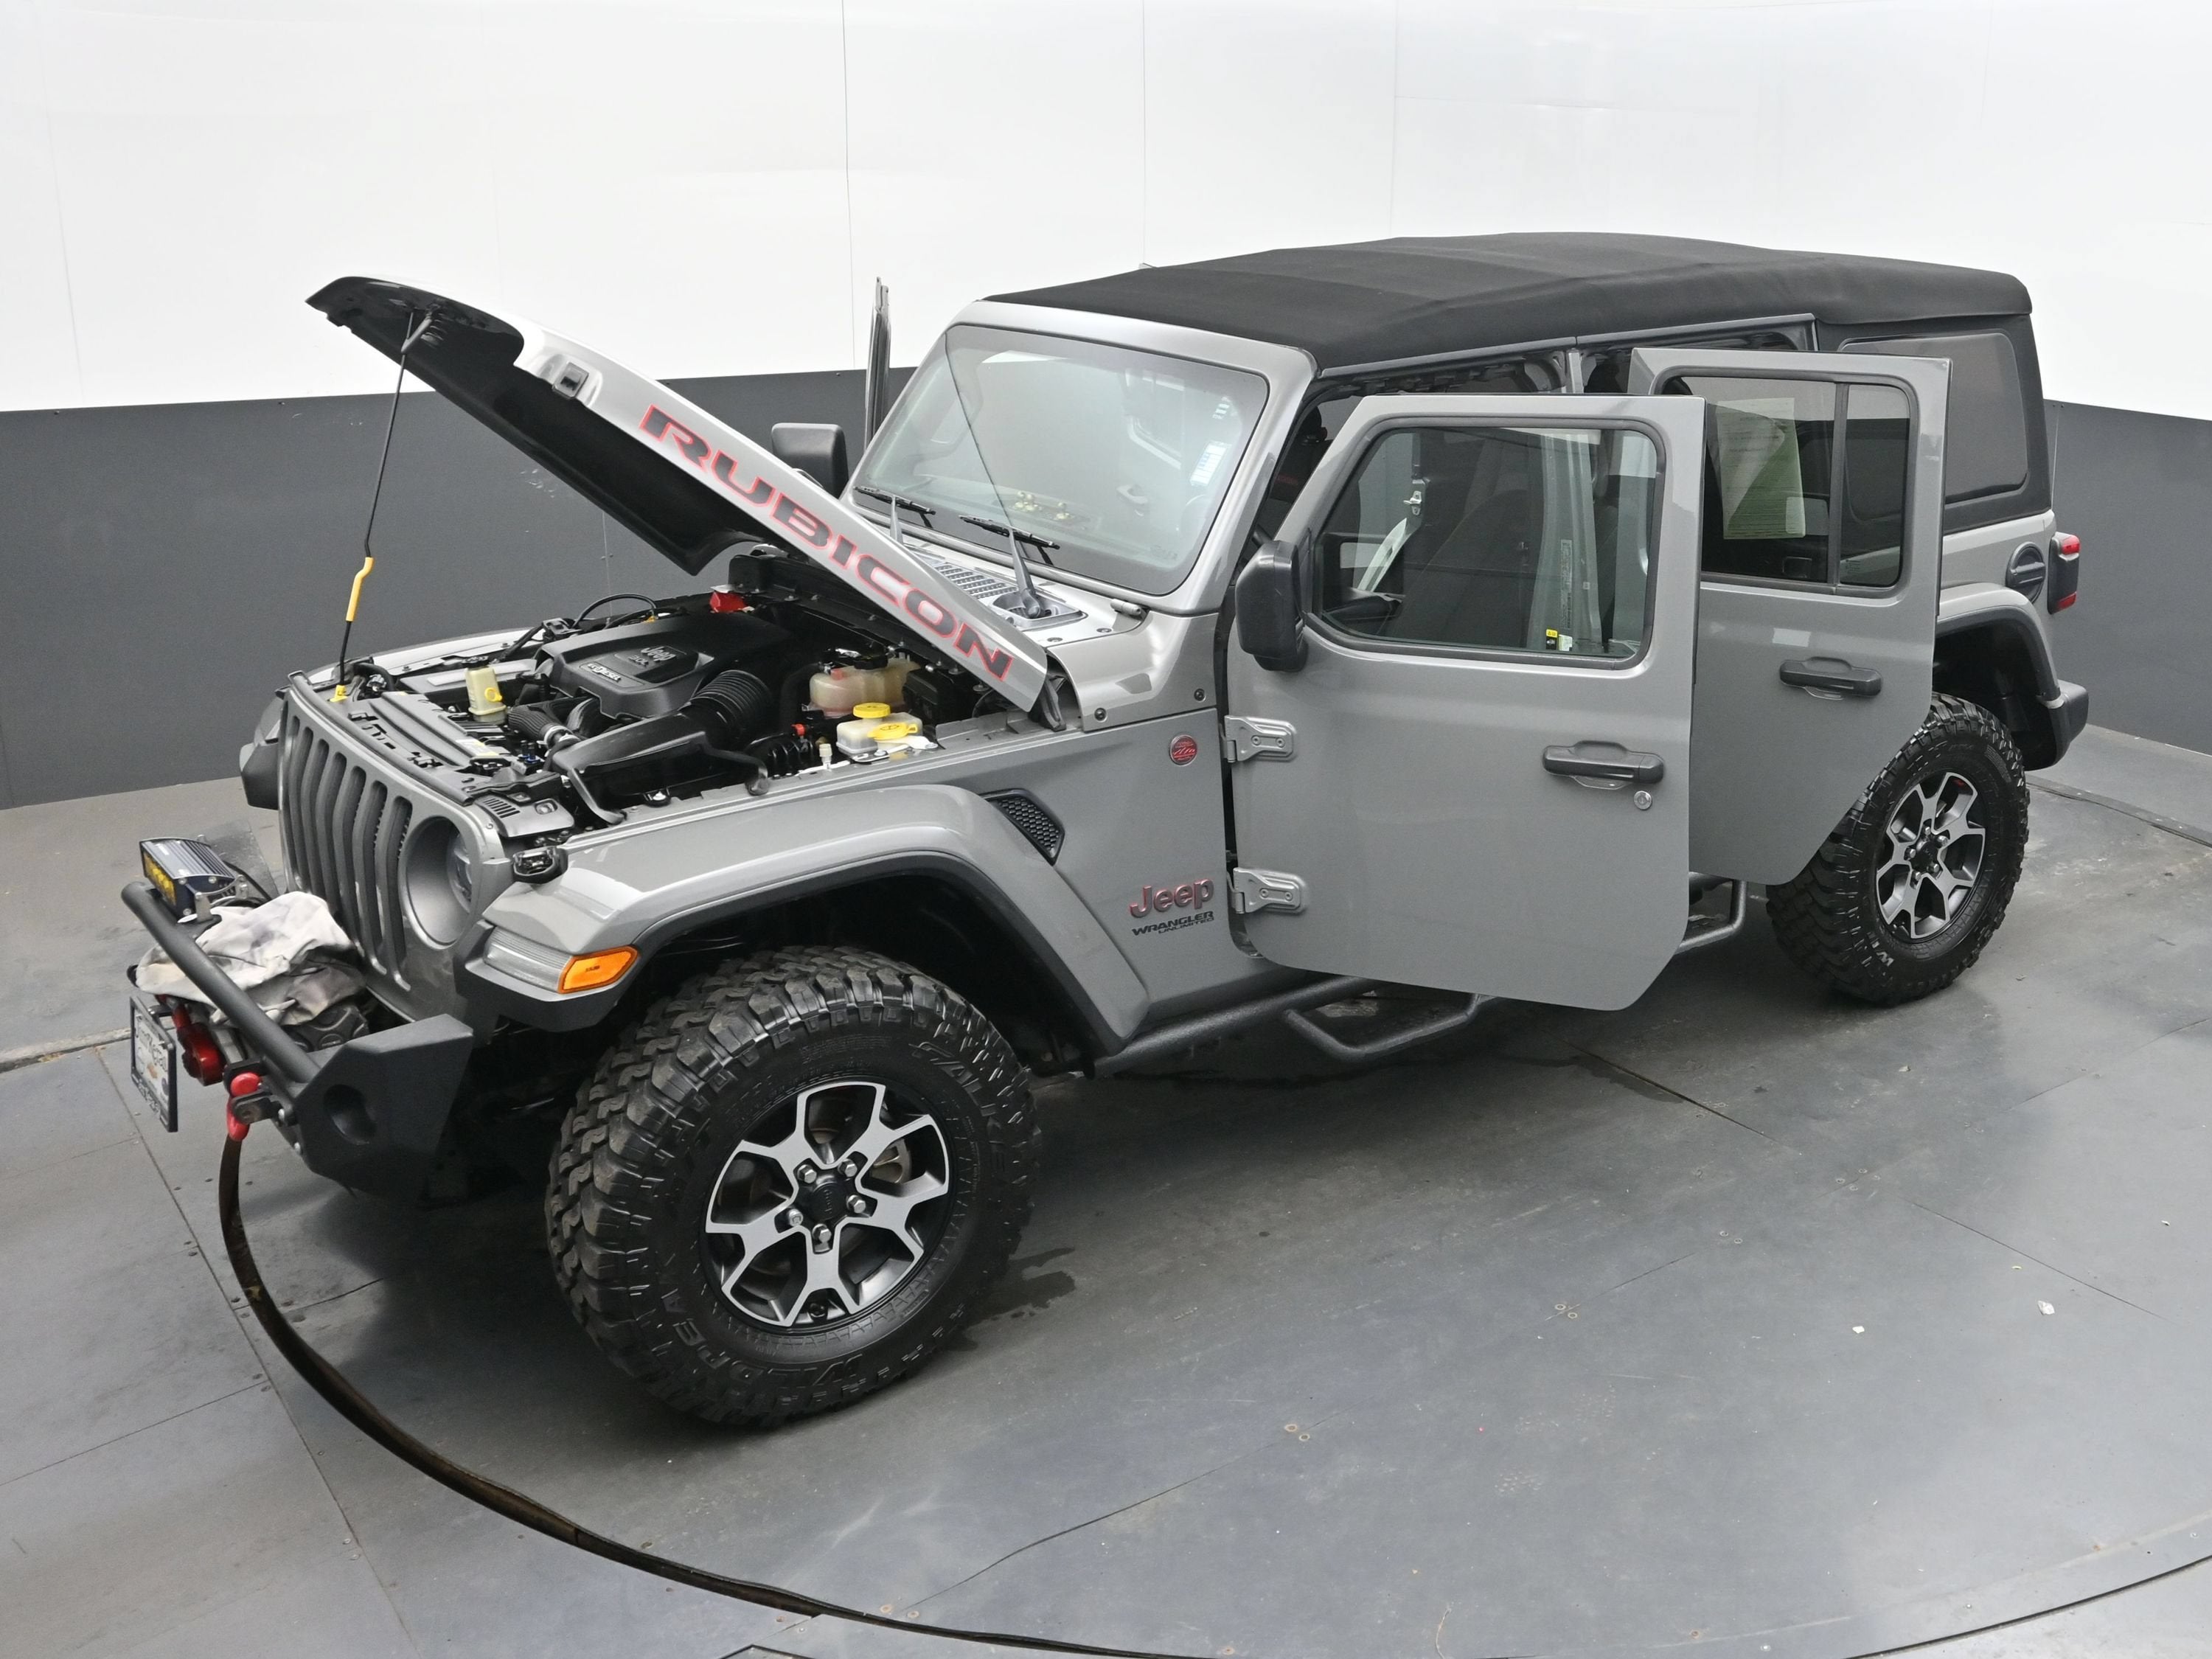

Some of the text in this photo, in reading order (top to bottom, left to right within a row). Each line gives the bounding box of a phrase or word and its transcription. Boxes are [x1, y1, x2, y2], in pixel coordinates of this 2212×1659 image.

[639, 404, 1015, 681] RUBICON
[640, 646, 676, 662] Jeep
[1129, 878, 1214, 918] Jeep
[1131, 911, 1214, 936] WRANGLER
[1158, 917, 1214, 934] UNLIMITED
